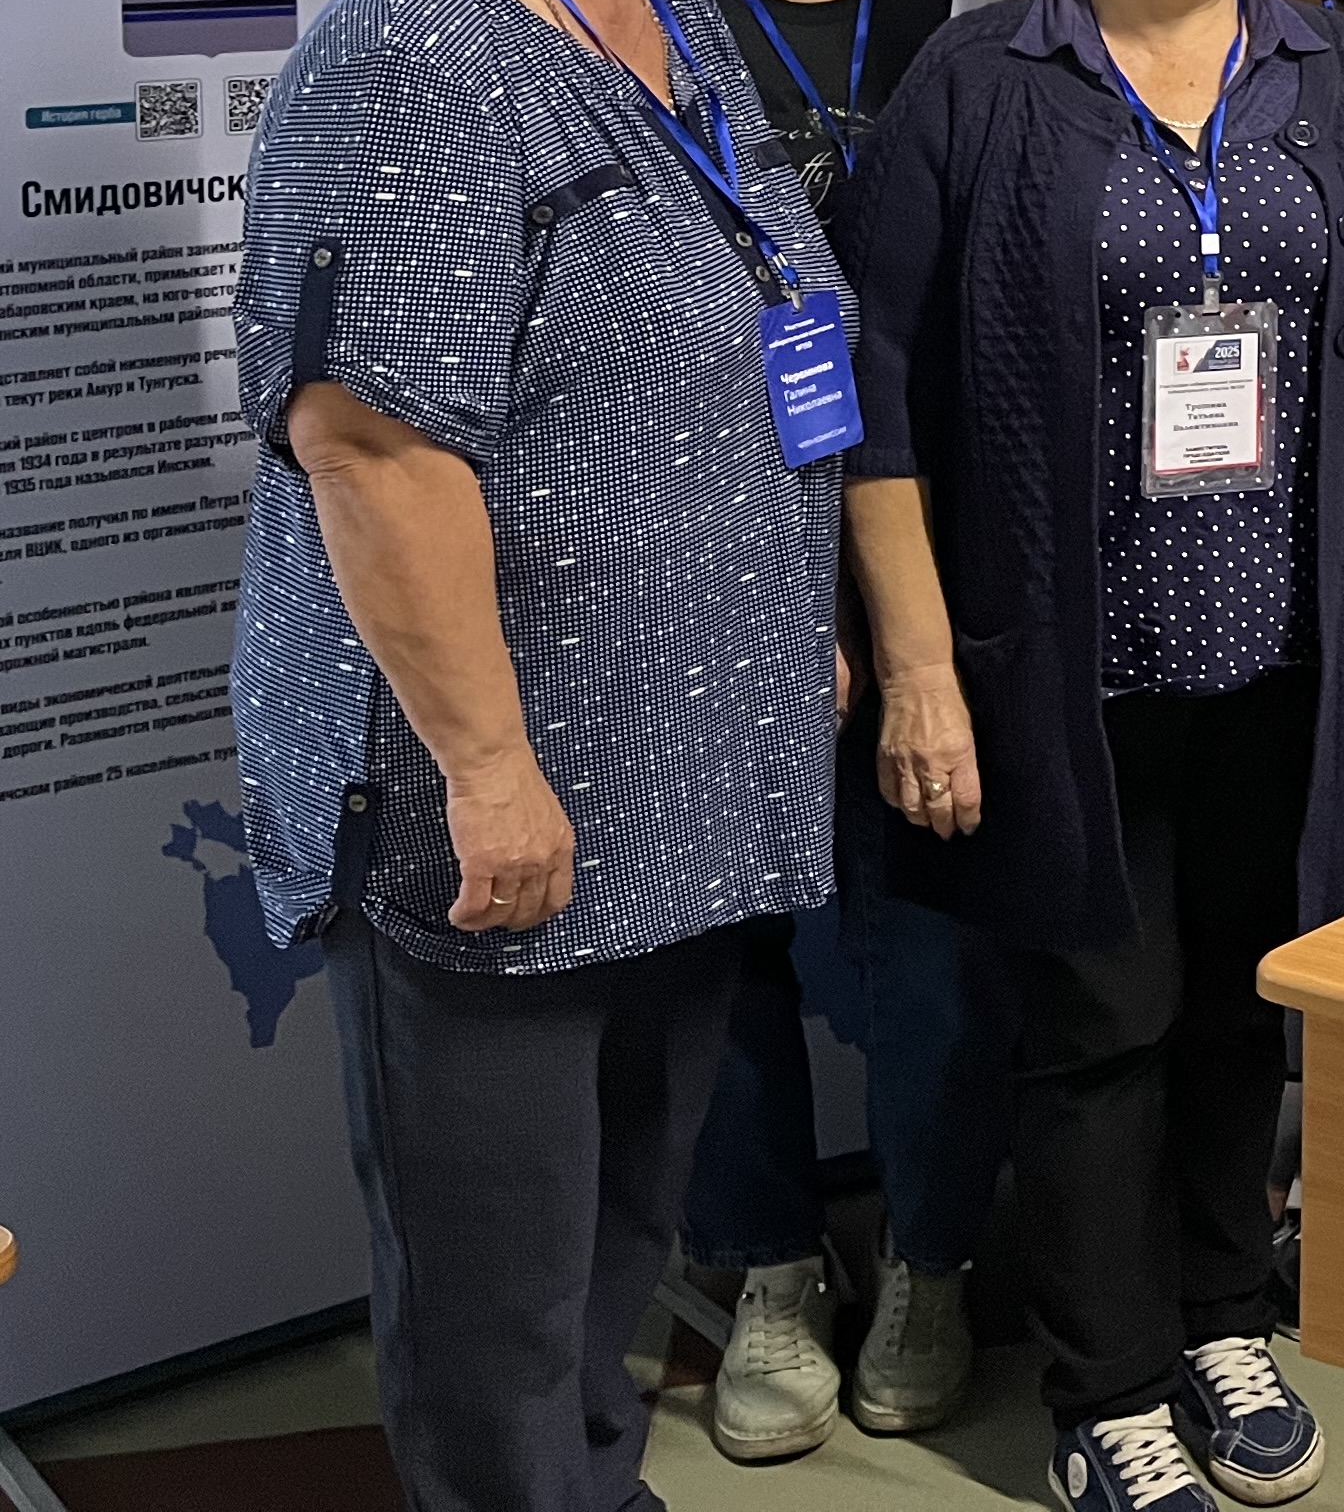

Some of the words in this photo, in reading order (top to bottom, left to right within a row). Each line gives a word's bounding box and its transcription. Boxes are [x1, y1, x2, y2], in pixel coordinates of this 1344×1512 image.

[21, 174, 247, 218] Смидовичск
[18, 248, 138, 274] муниципальный
[141, 244, 184, 263] район
[78, 272, 141, 290] области,
[145, 264, 224, 283] примыкает
[90, 294, 139, 312] краем,
[53, 311, 175, 336] муниципальным
[74, 359, 116, 377] собой
[119, 352, 201, 372] низменную
[1214, 345, 1240, 359] 2025
[4, 390, 45, 408] текут
[48, 386, 83, 405] реки
[86, 381, 123, 397] Амур
[138, 372, 203, 392] Тунгуска.
[24, 432, 67, 451] район
[82, 423, 143, 443] центром
[159, 412, 218, 433] рабочем
[21, 454, 51, 471] 1934
[55, 451, 88, 467] года
[103, 437, 181, 462] результате
[39, 474, 72, 491] года
[75, 463, 154, 486] назывался
[68, 509, 129, 531] получил
[151, 500, 196, 518] имени
[199, 493, 240, 510] Петра
[70, 533, 120, 552] одного
[142, 516, 246, 541] организаторов
[17, 596, 120, 624] особенностью
[123, 589, 172, 609] района
[15, 627, 72, 649] пунктов
[75, 620, 120, 638] вдоль
[123, 599, 217, 632] федеральной
[43, 674, 153, 708] экономической
[53, 771, 104, 795] районе
[105, 764, 124, 782] 25
